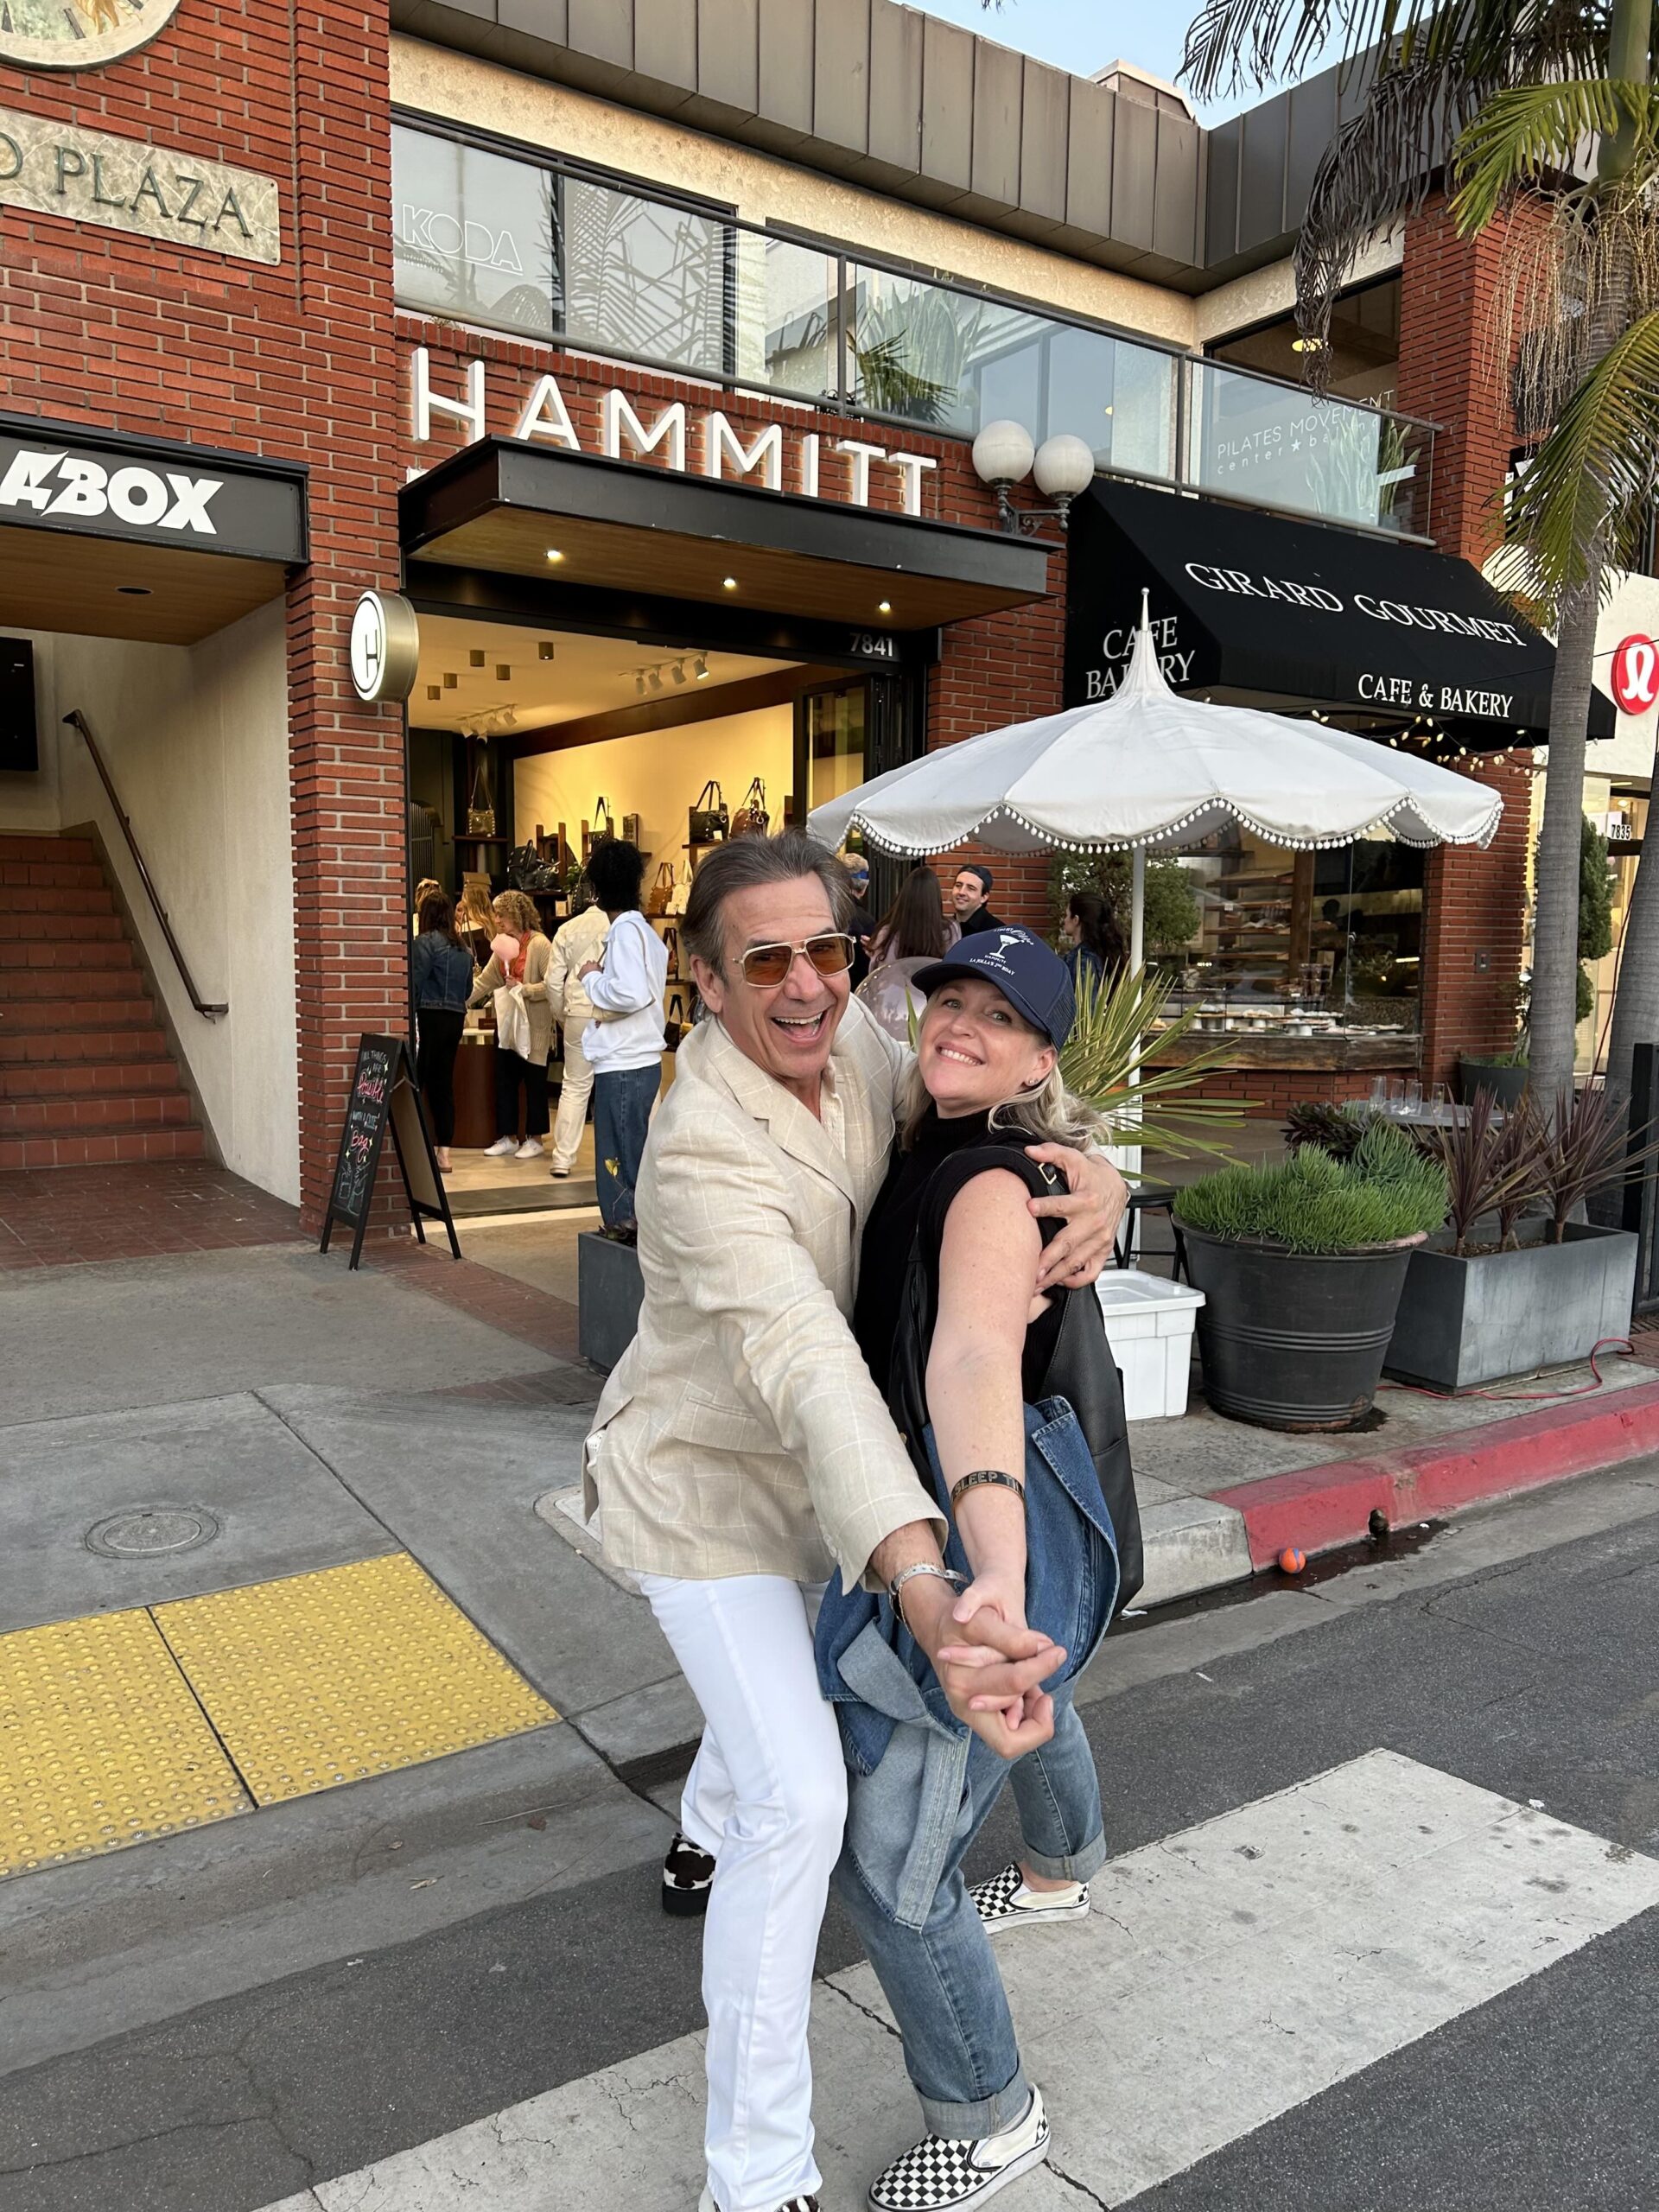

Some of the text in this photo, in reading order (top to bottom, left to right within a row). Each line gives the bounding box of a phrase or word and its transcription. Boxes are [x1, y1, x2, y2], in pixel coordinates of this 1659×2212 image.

[54, 145, 254, 238] PLAZA
[403, 204, 524, 271] KODA
[411, 346, 938, 517] HAMMITT
[1217, 426, 1282, 459] PILATES
[1217, 448, 1282, 474] center
[1184, 563, 1528, 646] GIRARD GOURMET
[849, 632, 893, 657] 7841
[1085, 650, 1196, 699] BARY
[1357, 673, 1514, 718] CAFE & BAKERY
[1611, 824, 1630, 840] 7835
[955, 1471, 998, 1496] SLEEP
